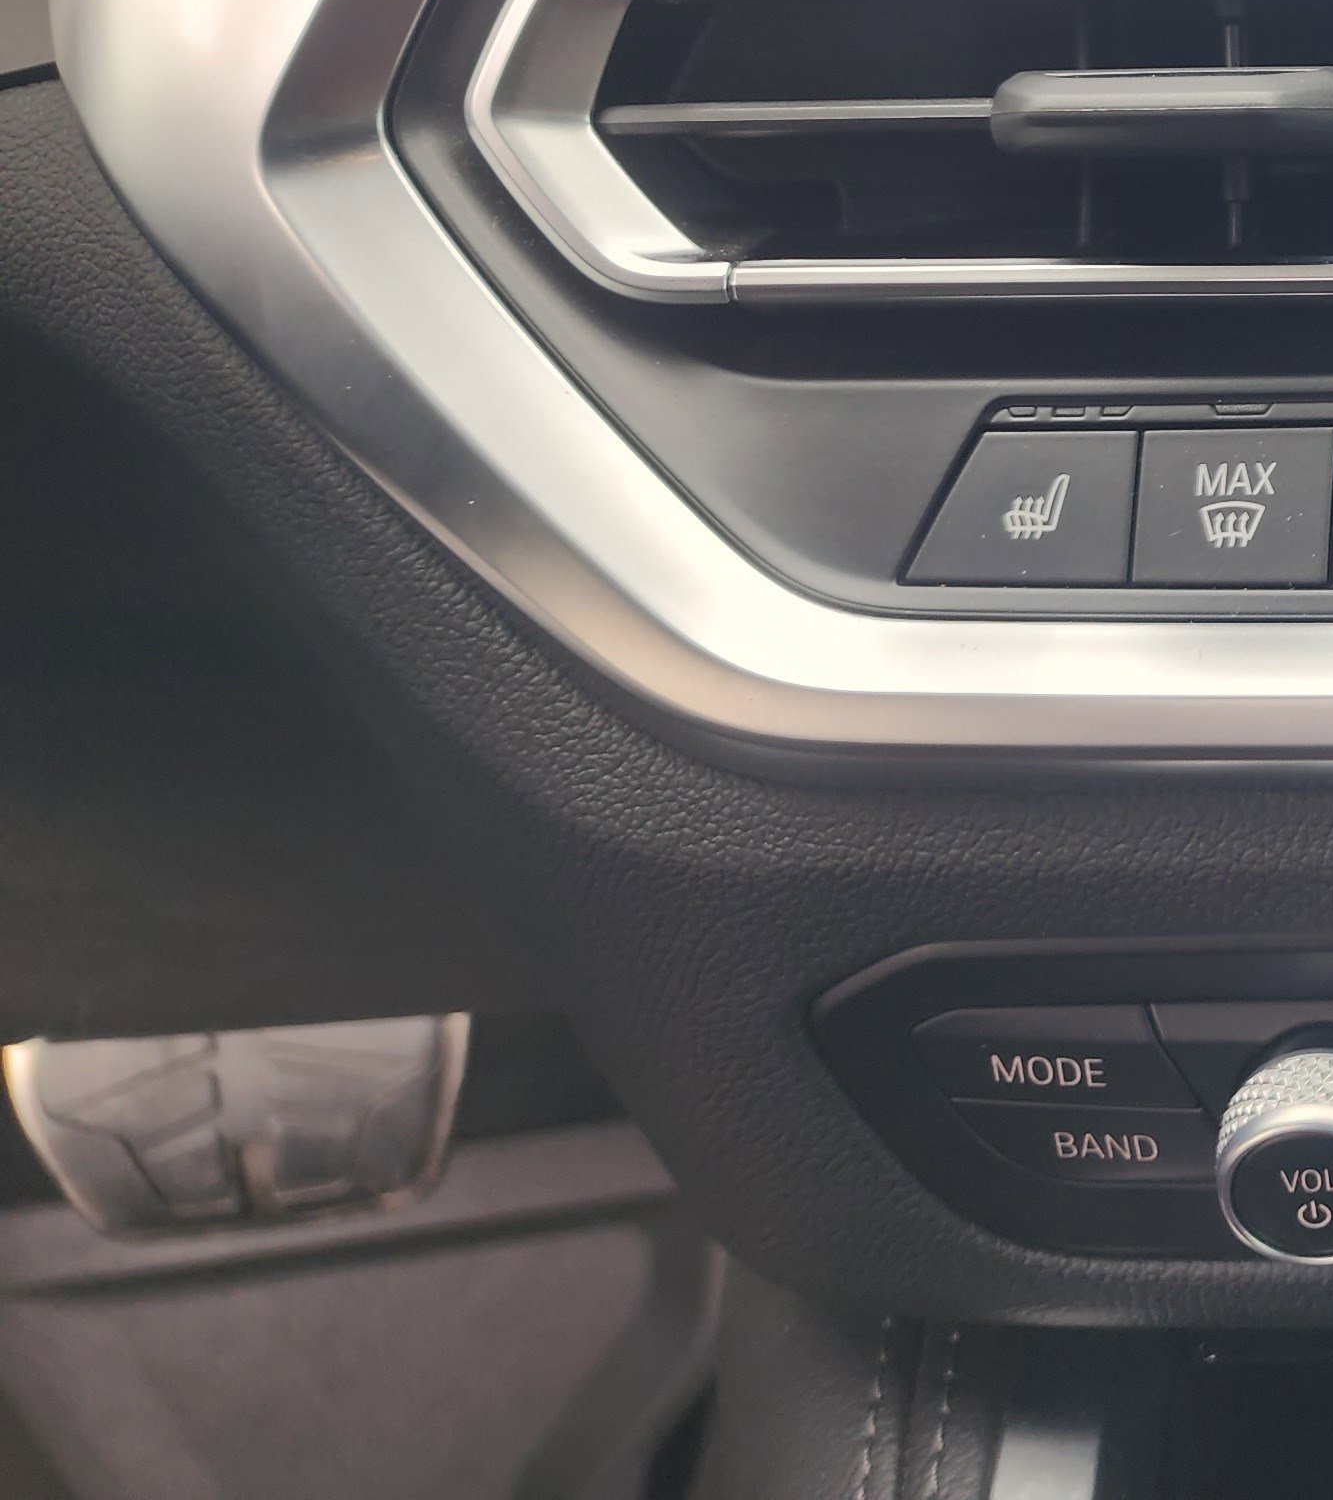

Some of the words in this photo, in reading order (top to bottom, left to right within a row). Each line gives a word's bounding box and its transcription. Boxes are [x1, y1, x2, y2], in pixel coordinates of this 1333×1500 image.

[1196, 461, 1278, 497] MAX
[990, 1054, 1107, 1088] MODE
[1053, 1131, 1158, 1162] BAND
